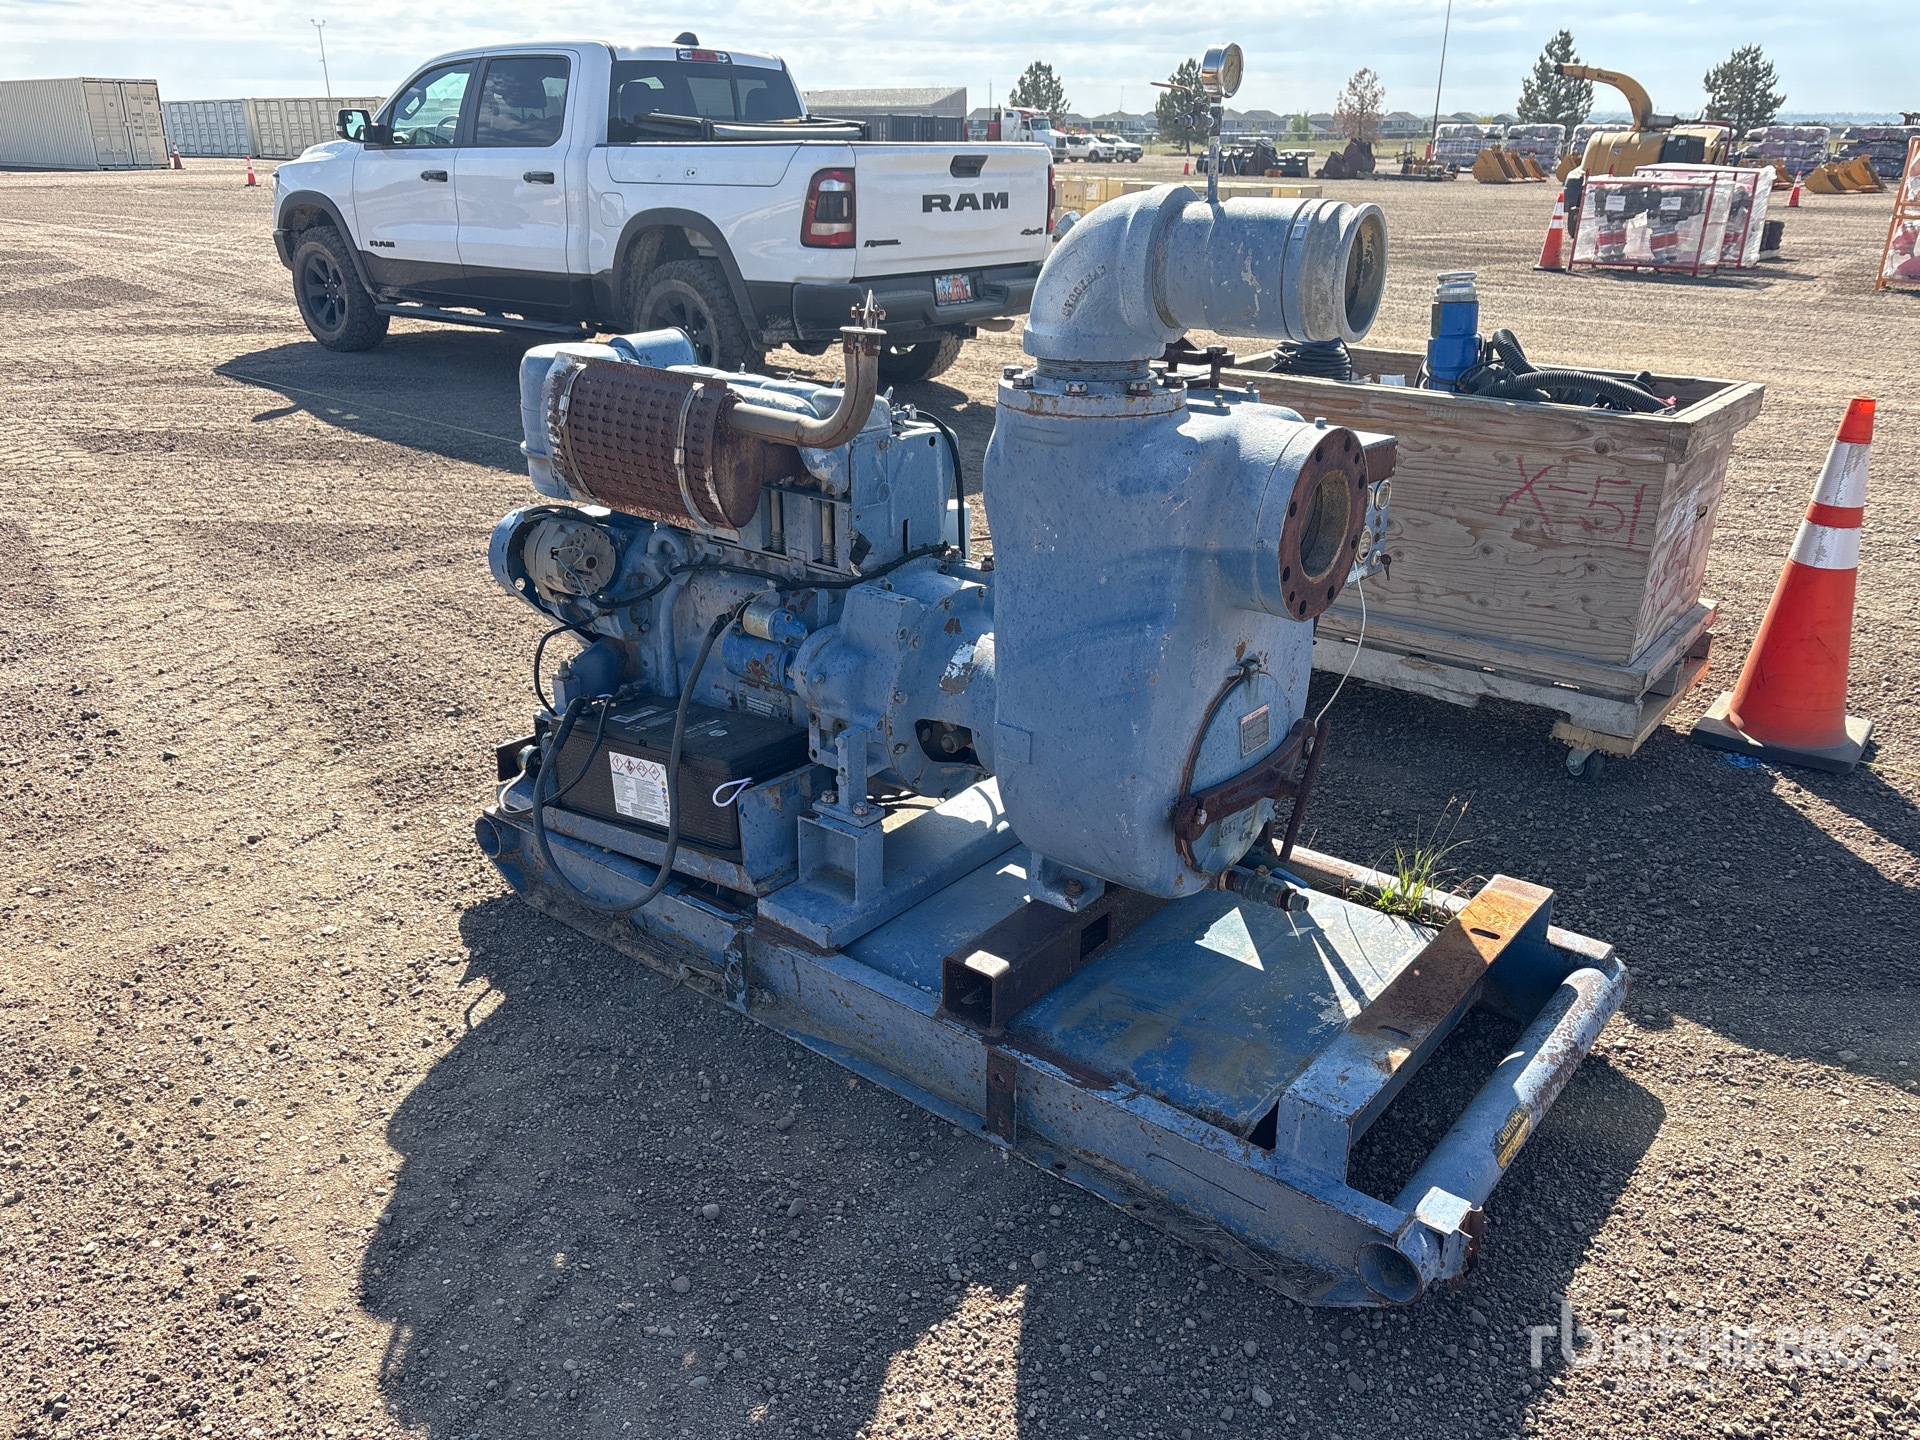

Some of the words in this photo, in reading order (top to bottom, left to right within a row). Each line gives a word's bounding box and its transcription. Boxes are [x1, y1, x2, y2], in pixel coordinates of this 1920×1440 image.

[922, 192, 1009, 213] RAM
[369, 240, 396, 248] RAM
[1497, 454, 1649, 547] X-51
[1497, 1110, 1525, 1146] CAUTION
